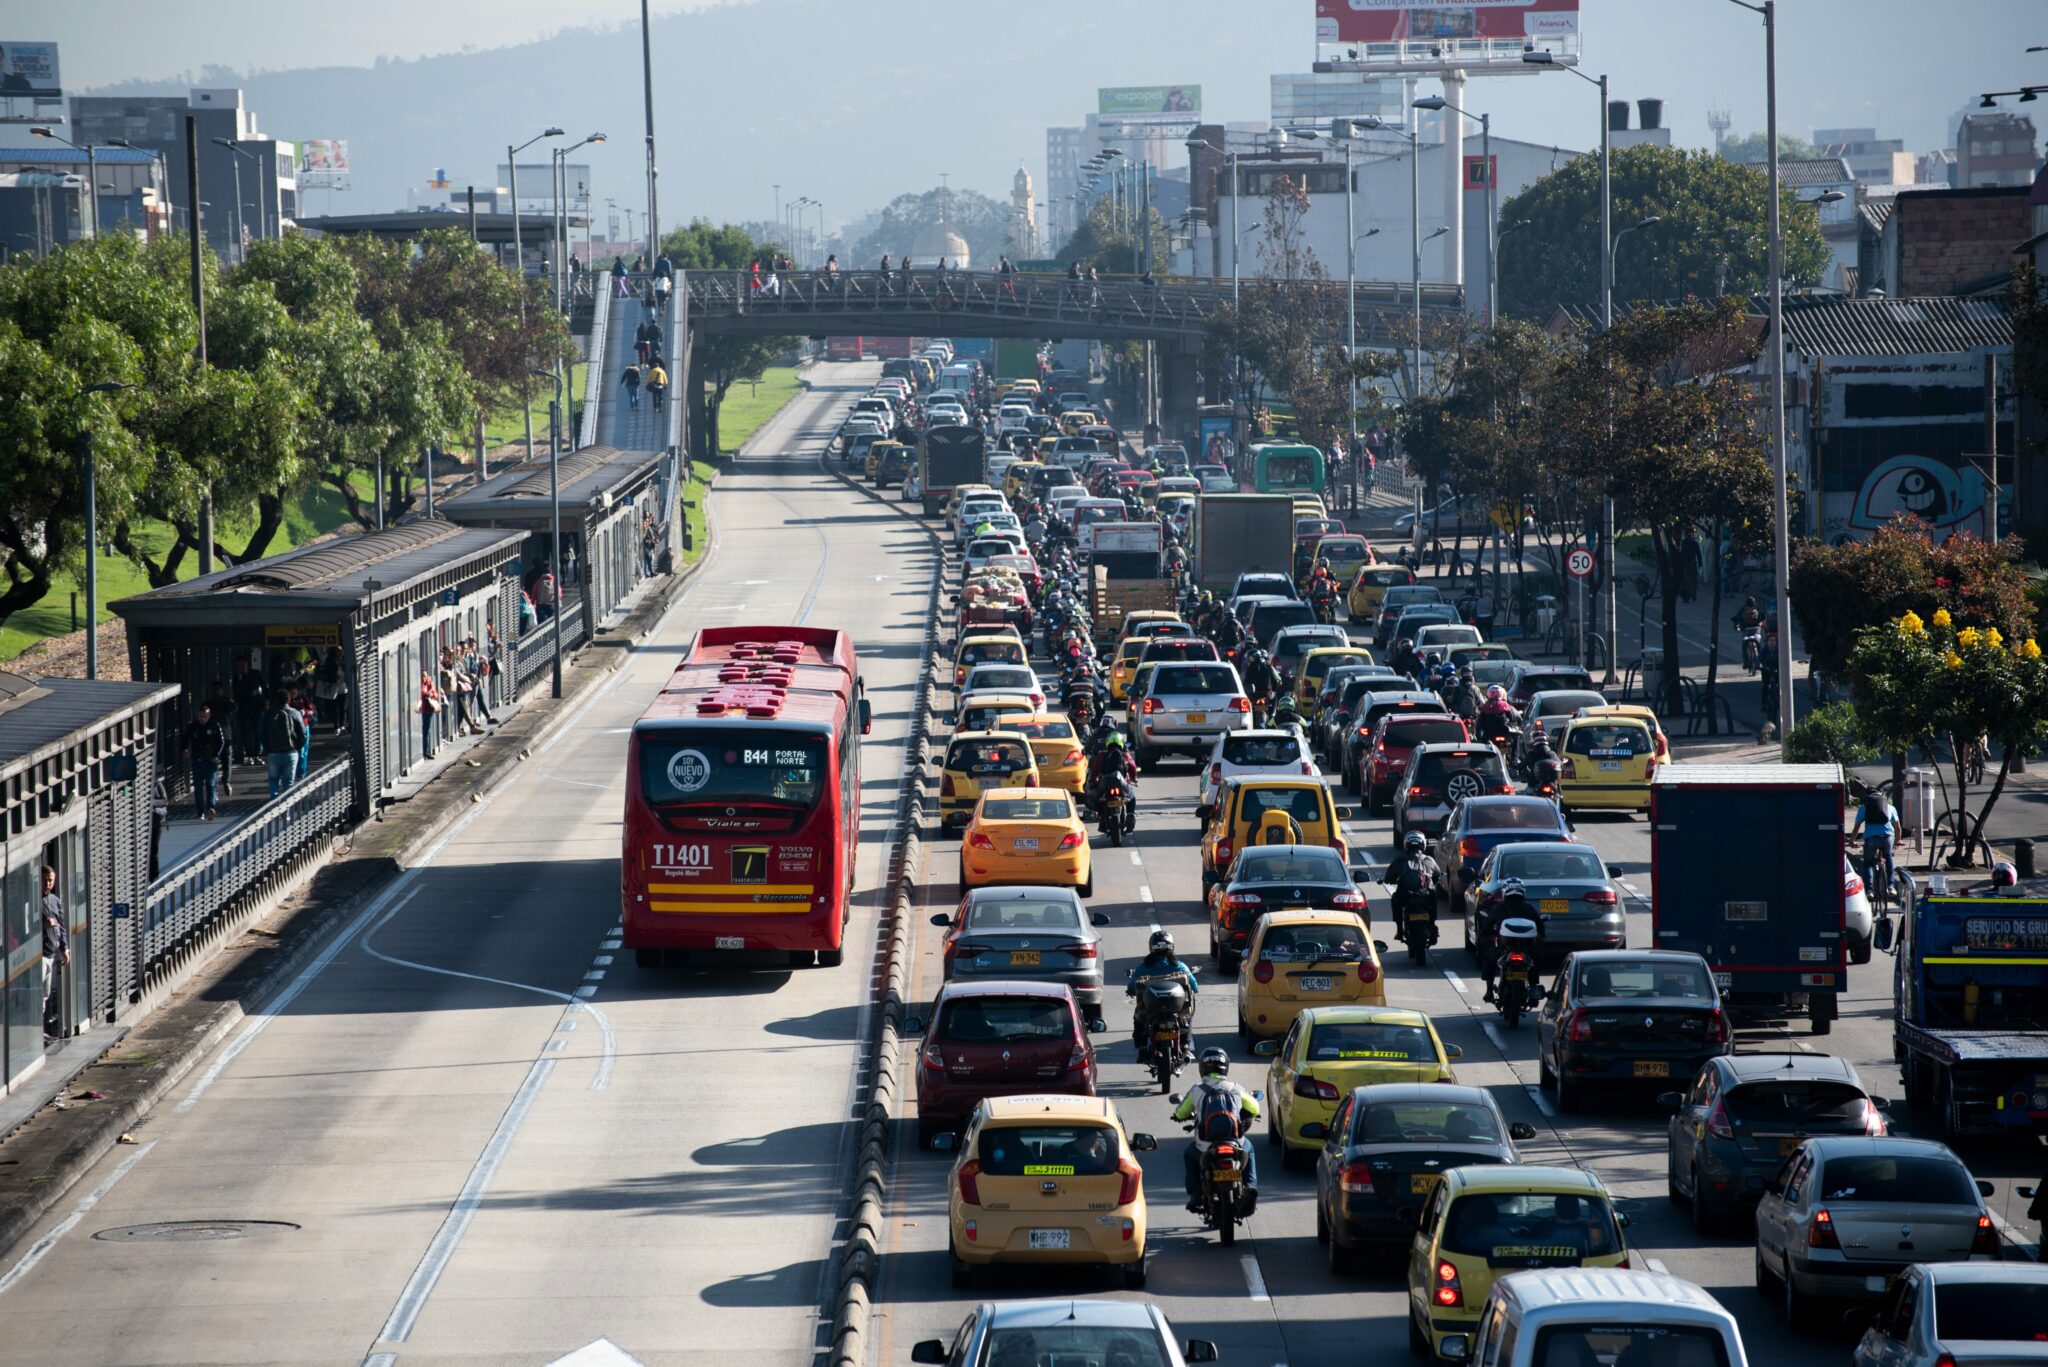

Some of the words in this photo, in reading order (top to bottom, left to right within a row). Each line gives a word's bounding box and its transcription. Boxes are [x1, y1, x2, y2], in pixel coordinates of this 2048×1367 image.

[1116, 91, 1163, 103] expopet
[1572, 556, 1590, 569] 50
[447, 592, 454, 604] 3
[682, 757, 694, 765] SOY
[744, 750, 768, 764] B44
[675, 766, 703, 777] NUEVO
[653, 844, 709, 866] T1401
[118, 905, 126, 917] 3
[1966, 921, 2011, 934] SERVICIO
[2013, 921, 2026, 934] DE
[2028, 921, 2048, 934] GRU
